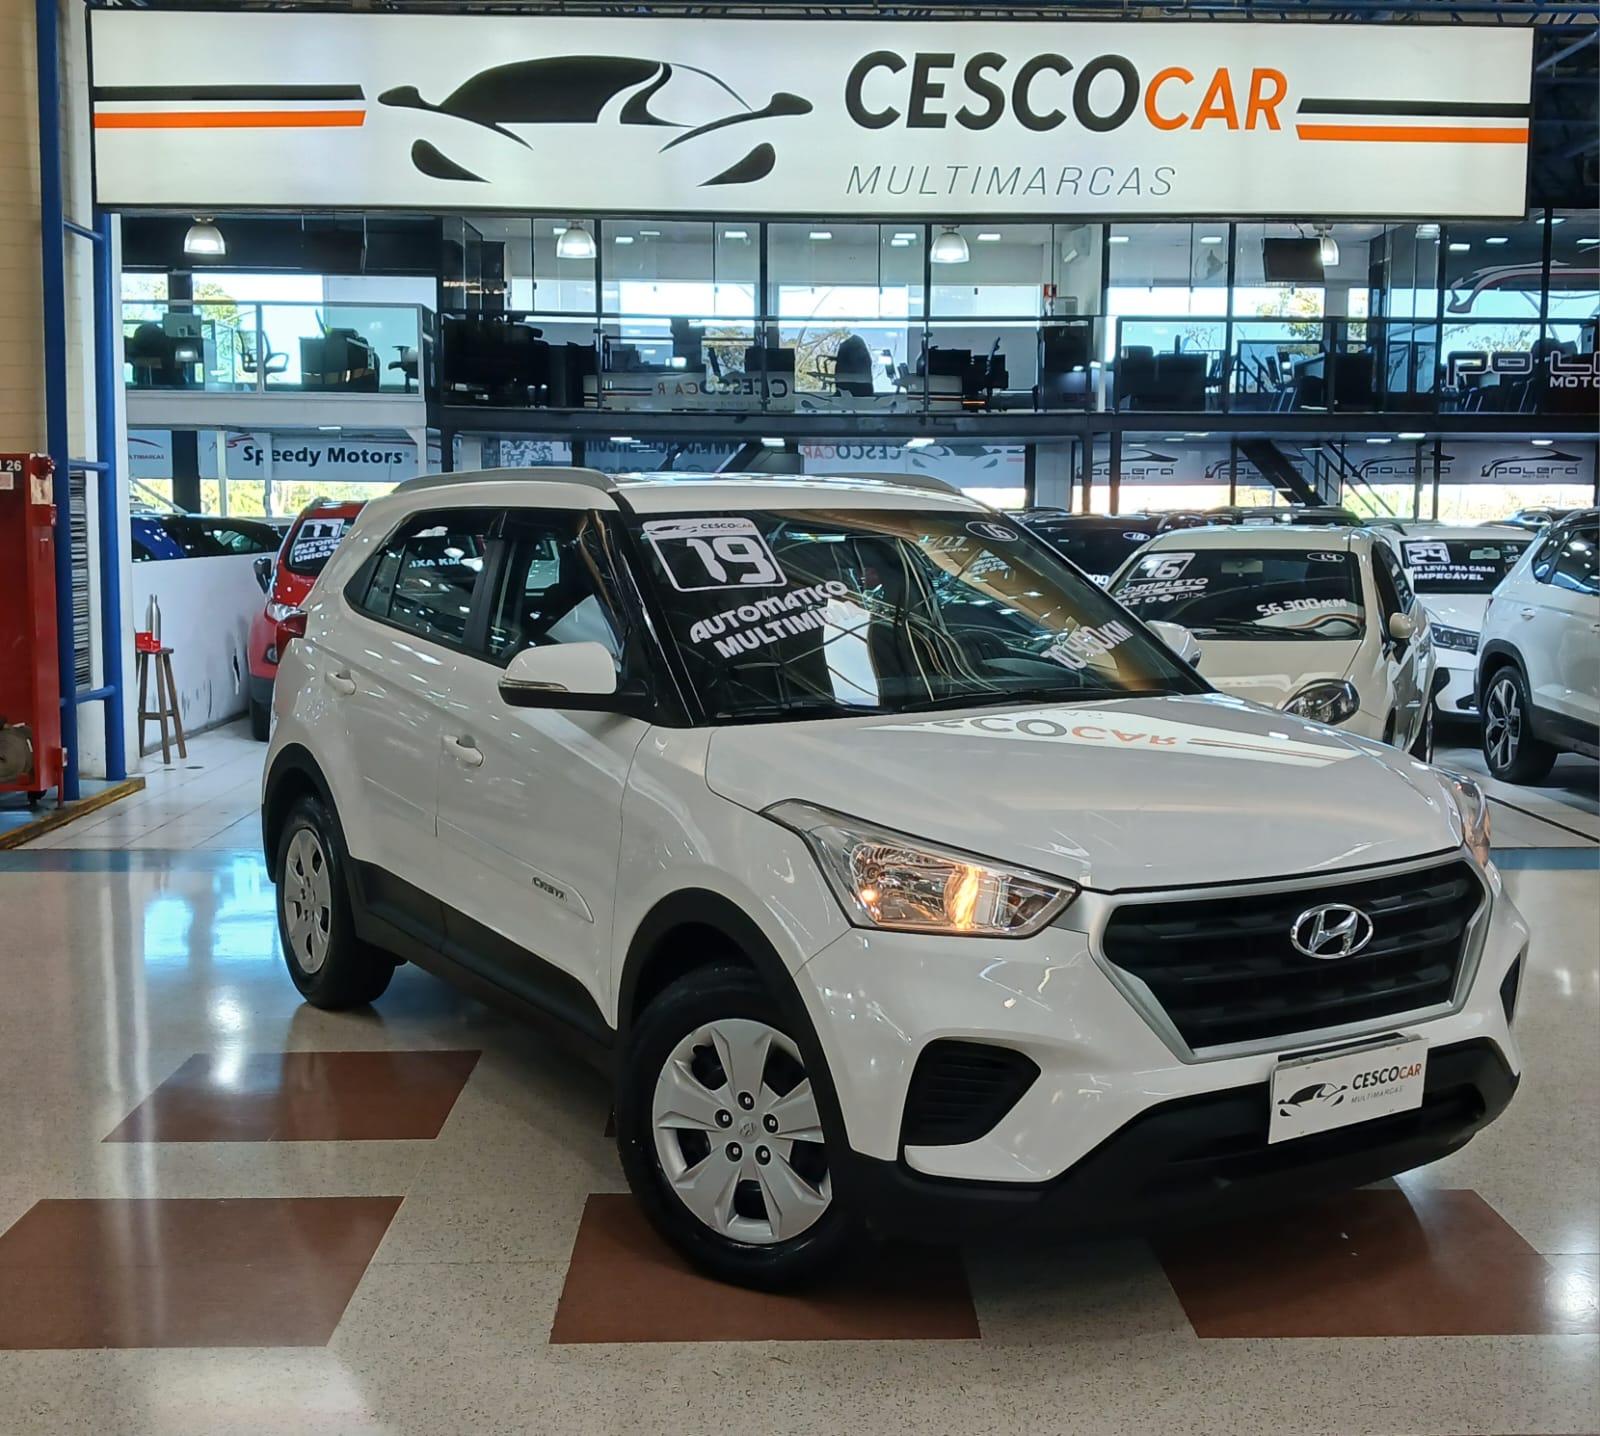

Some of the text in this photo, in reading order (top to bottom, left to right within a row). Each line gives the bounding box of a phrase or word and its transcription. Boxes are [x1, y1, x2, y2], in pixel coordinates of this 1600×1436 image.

[845, 50, 1288, 132] CESCOCAR
[845, 165, 1177, 197] MULTIMARCAS
[6, 460, 22, 471] 26
[243, 445, 321, 468] Speedy
[327, 447, 403, 464] Motors
[686, 536, 777, 584] 19
[1409, 548, 1449, 564] 24
[1352, 1063, 1422, 1090] CESCOCAR
